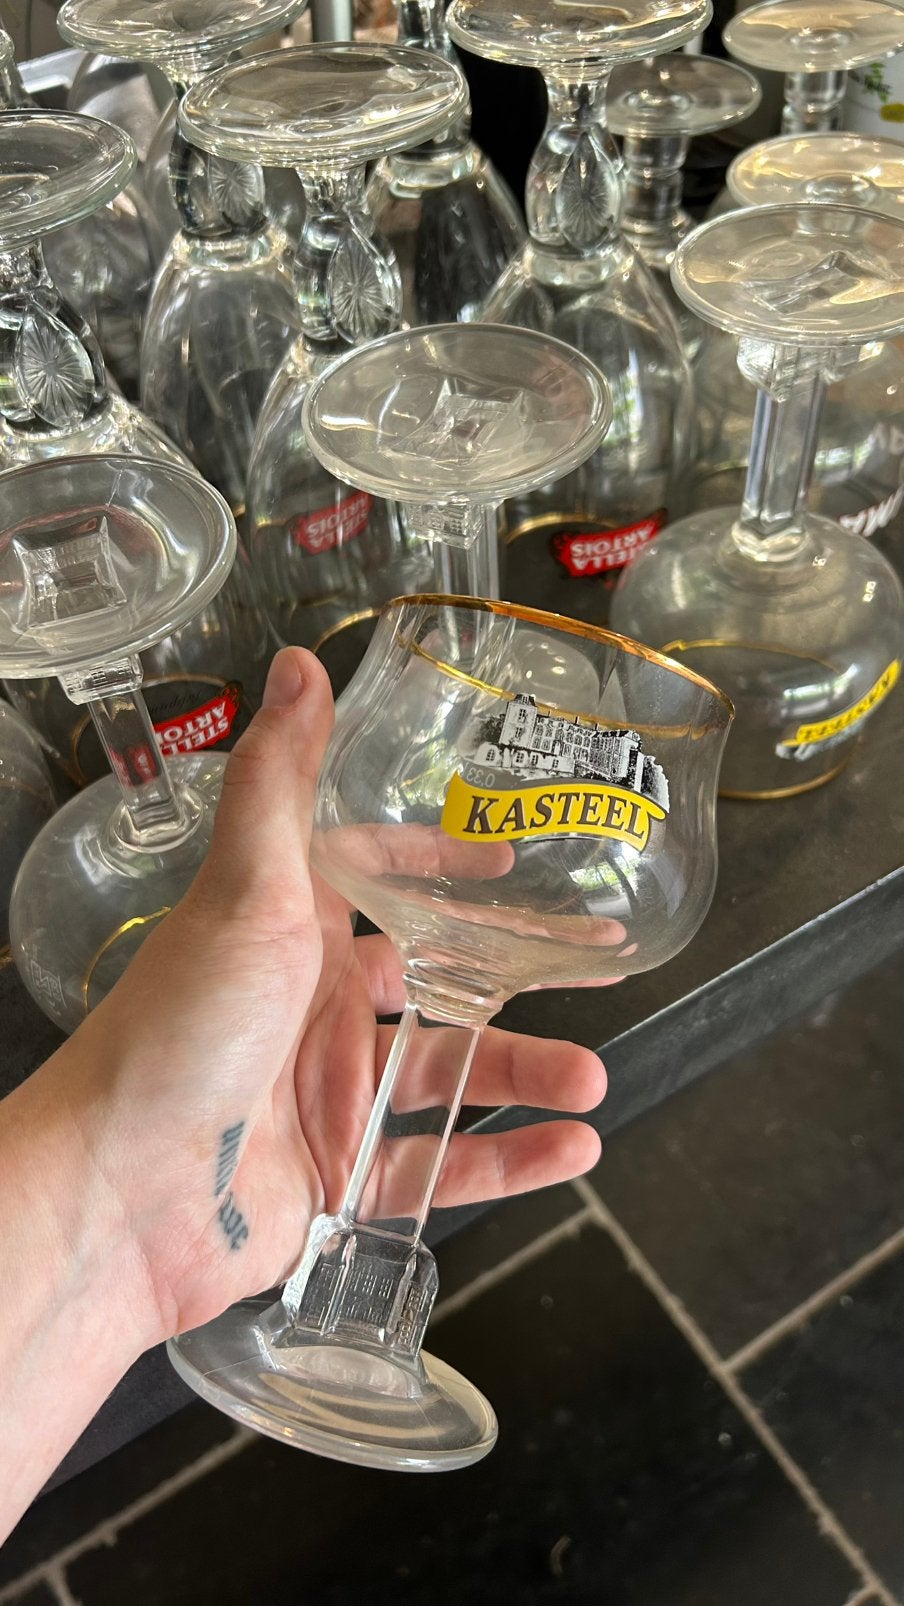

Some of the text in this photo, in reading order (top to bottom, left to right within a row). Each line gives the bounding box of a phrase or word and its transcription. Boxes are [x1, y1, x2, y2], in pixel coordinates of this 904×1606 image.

[570, 524, 655, 558] ARTOIS
[161, 715, 229, 757] STELL
[462, 791, 646, 841] KASTEEL
